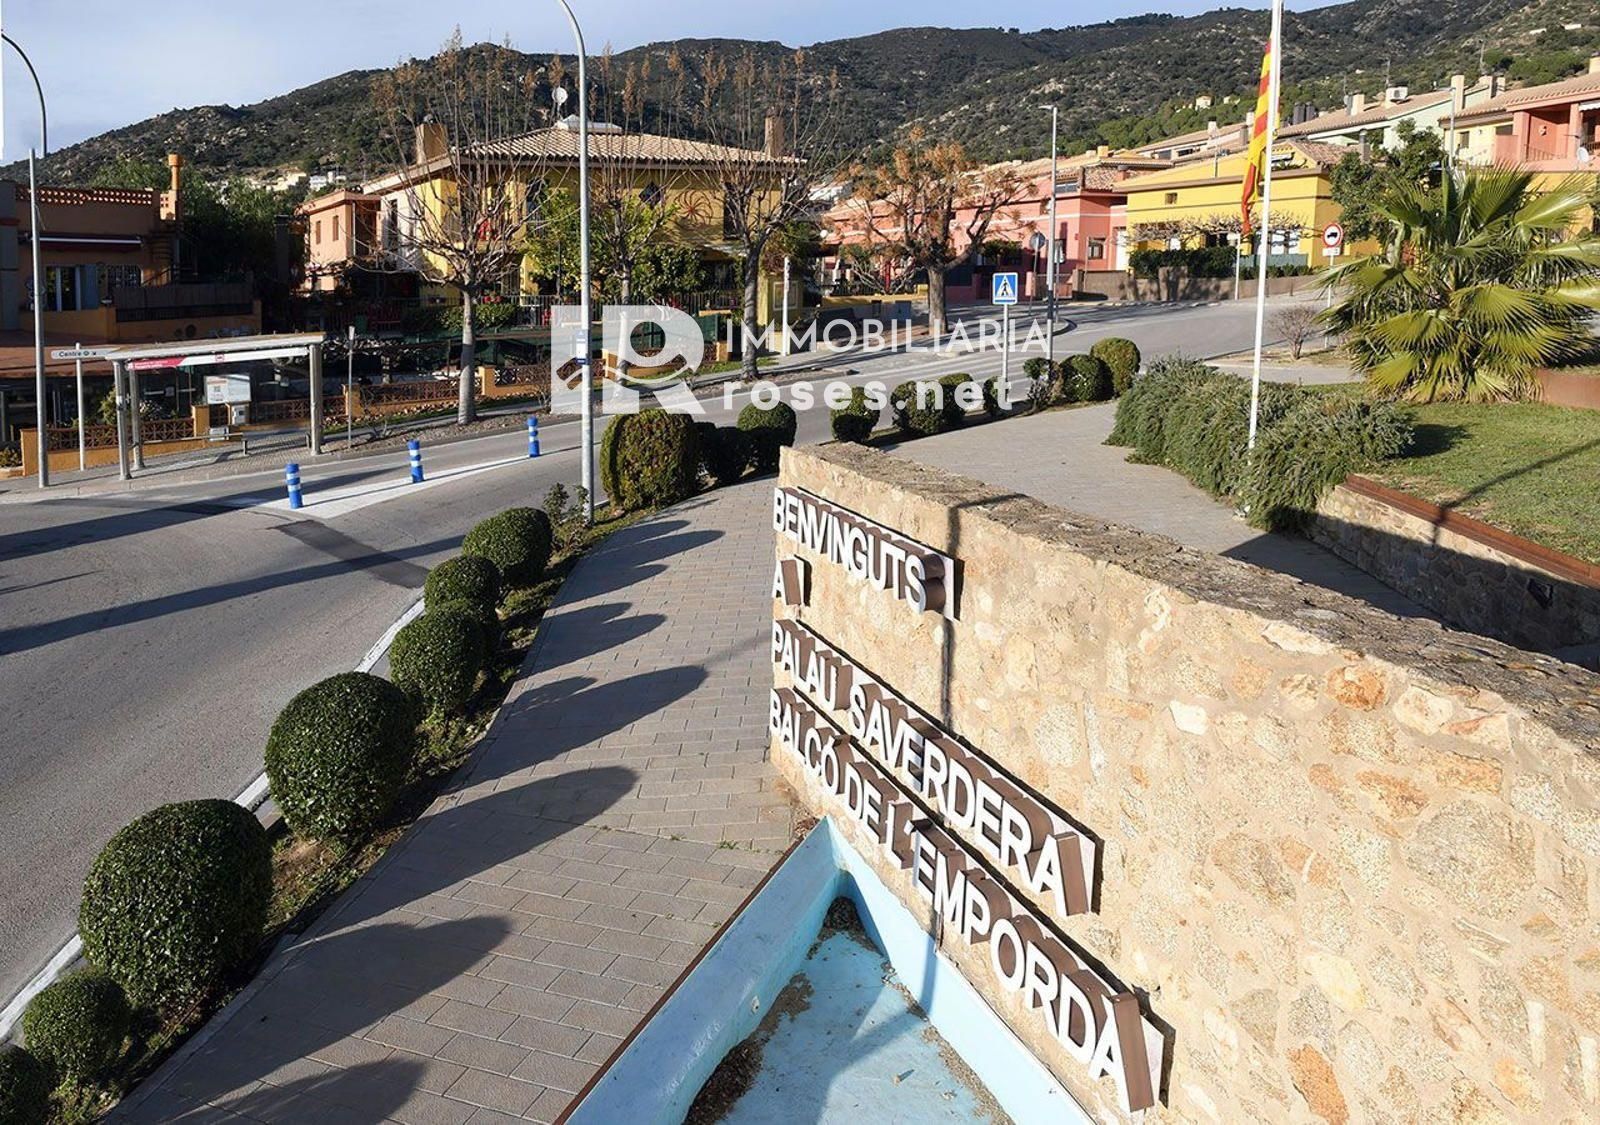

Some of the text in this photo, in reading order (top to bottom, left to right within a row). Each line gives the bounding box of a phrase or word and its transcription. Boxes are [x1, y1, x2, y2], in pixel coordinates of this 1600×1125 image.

[773, 487, 927, 615] BENVINGUTS
[769, 688, 839, 794] BALCÓ
[771, 622, 1067, 917] PALAU SAVERDERA
